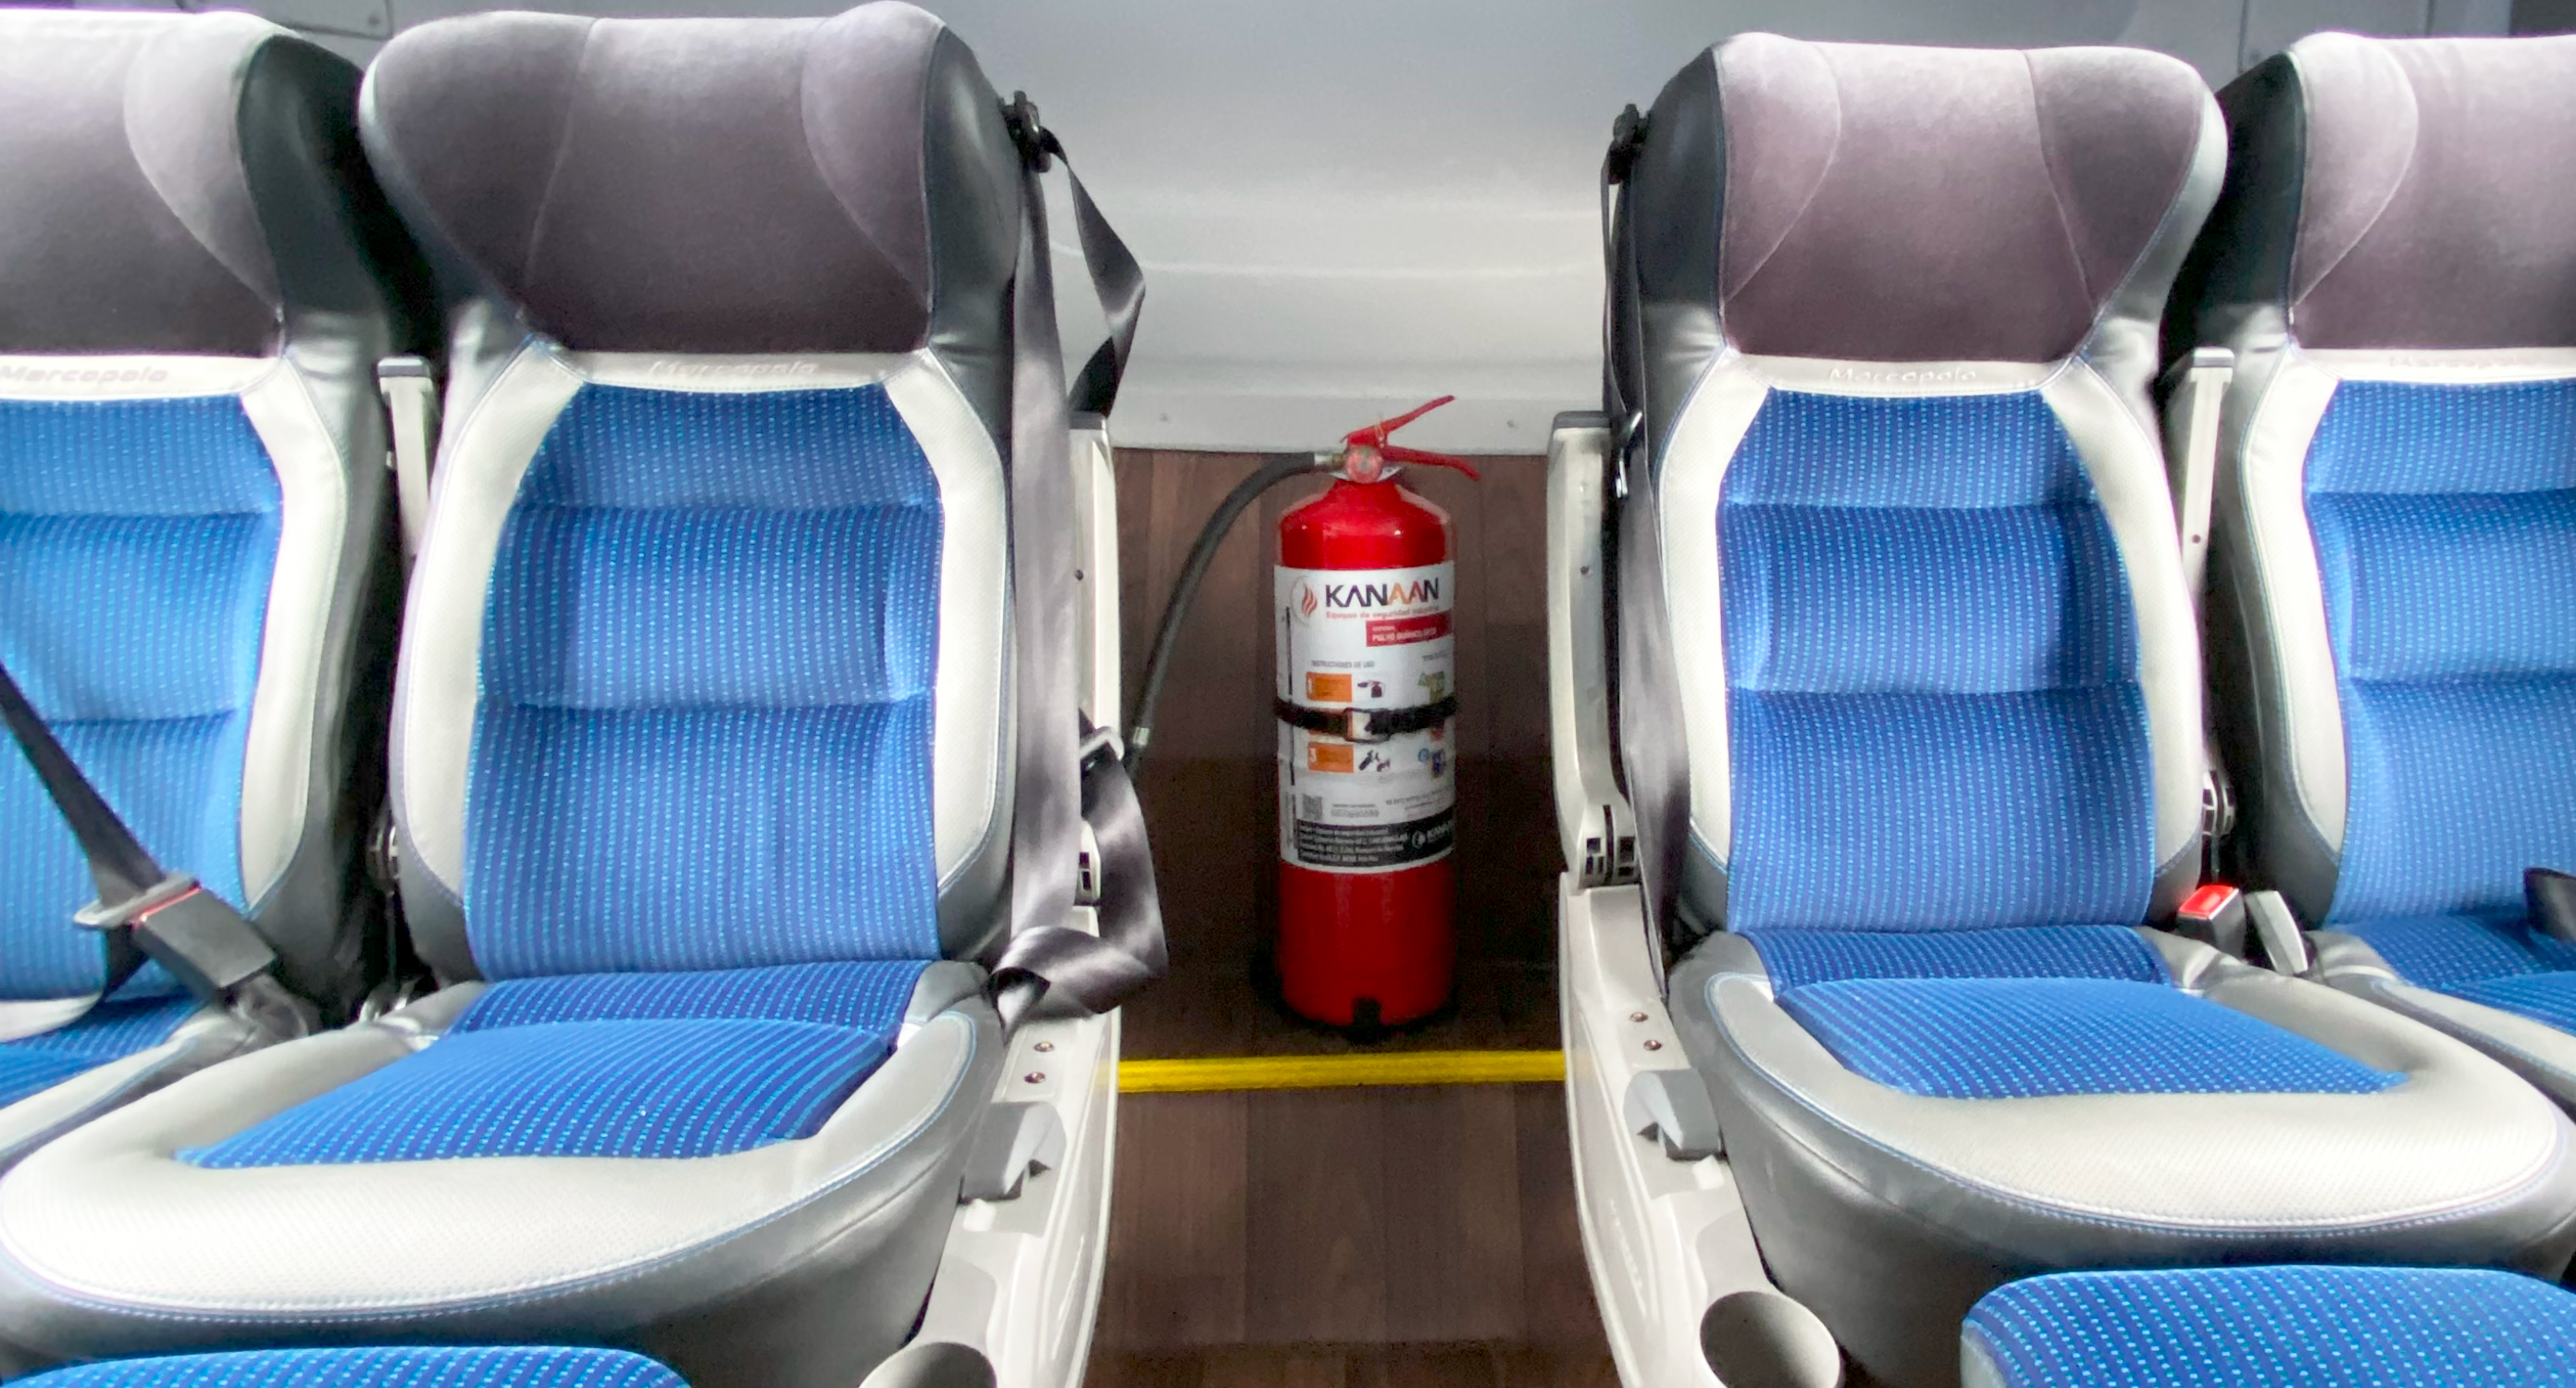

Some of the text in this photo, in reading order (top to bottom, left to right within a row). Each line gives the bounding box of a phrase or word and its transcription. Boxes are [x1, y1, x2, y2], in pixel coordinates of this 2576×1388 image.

[0, 366, 168, 384] Marcopolo
[1828, 367, 1976, 384] Marcopolo
[1325, 577, 1440, 608] KANAAN
